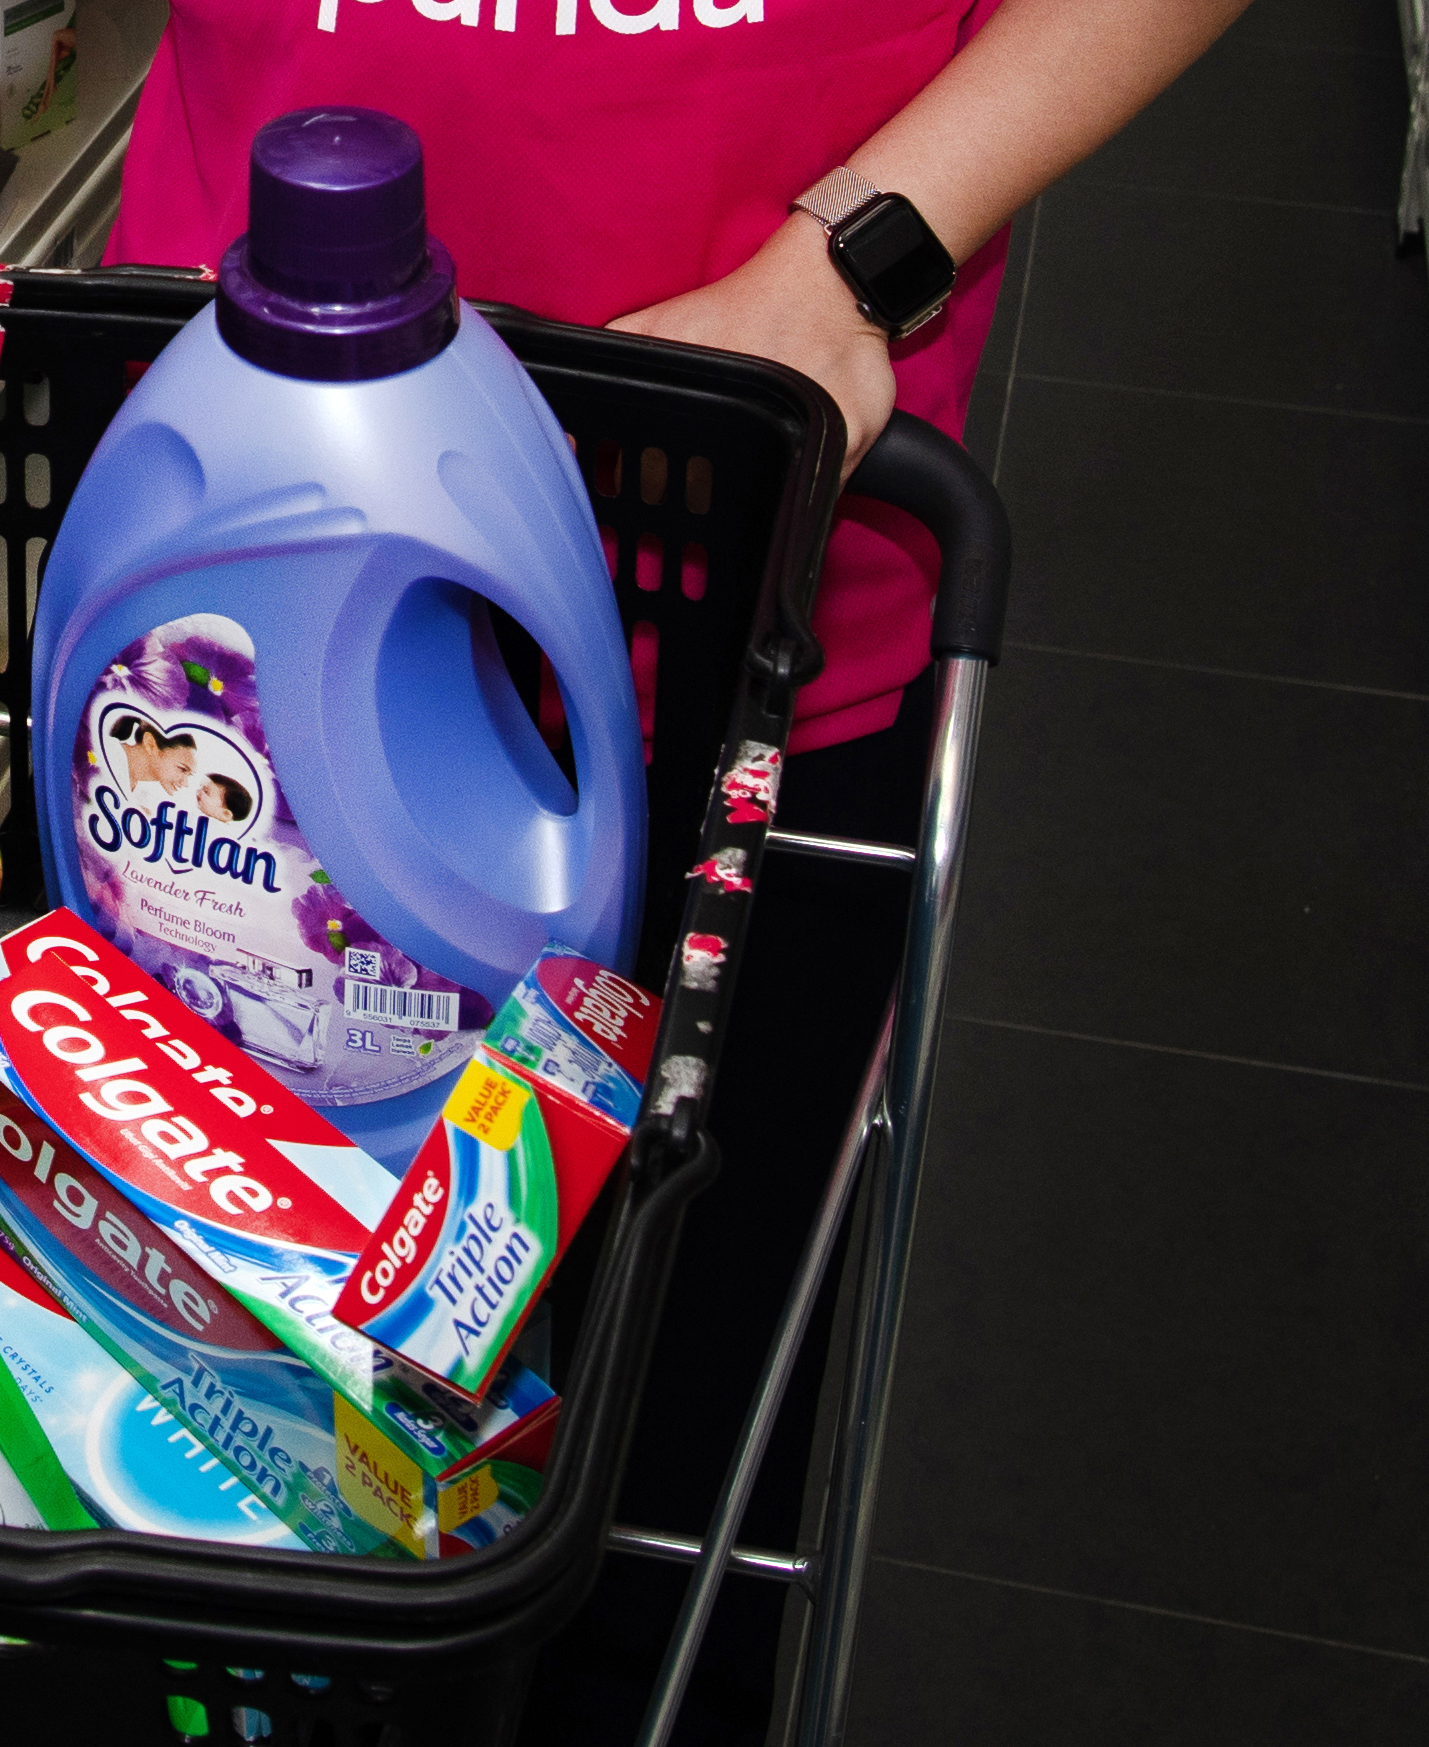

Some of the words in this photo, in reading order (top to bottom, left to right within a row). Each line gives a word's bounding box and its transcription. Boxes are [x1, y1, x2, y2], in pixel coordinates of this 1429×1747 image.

[89, 785, 282, 894] Softlan
[121, 859, 192, 904] Lavender
[195, 887, 247, 919] Fresh
[139, 898, 192, 931] Perfume
[193, 915, 237, 945] Bloom
[157, 921, 218, 955] Technology
[346, 1028, 381, 1053] 3L
[10, 989, 274, 1216] Colgate
[463, 1075, 499, 1123] VALUE
[23, 1255, 63, 1308] Original
[428, 1201, 505, 1307] Triple
[452, 1229, 531, 1356] Action
[159, 1367, 284, 1501] Action
[190, 1355, 293, 1475] Triple
[344, 1434, 413, 1510] VALUE
